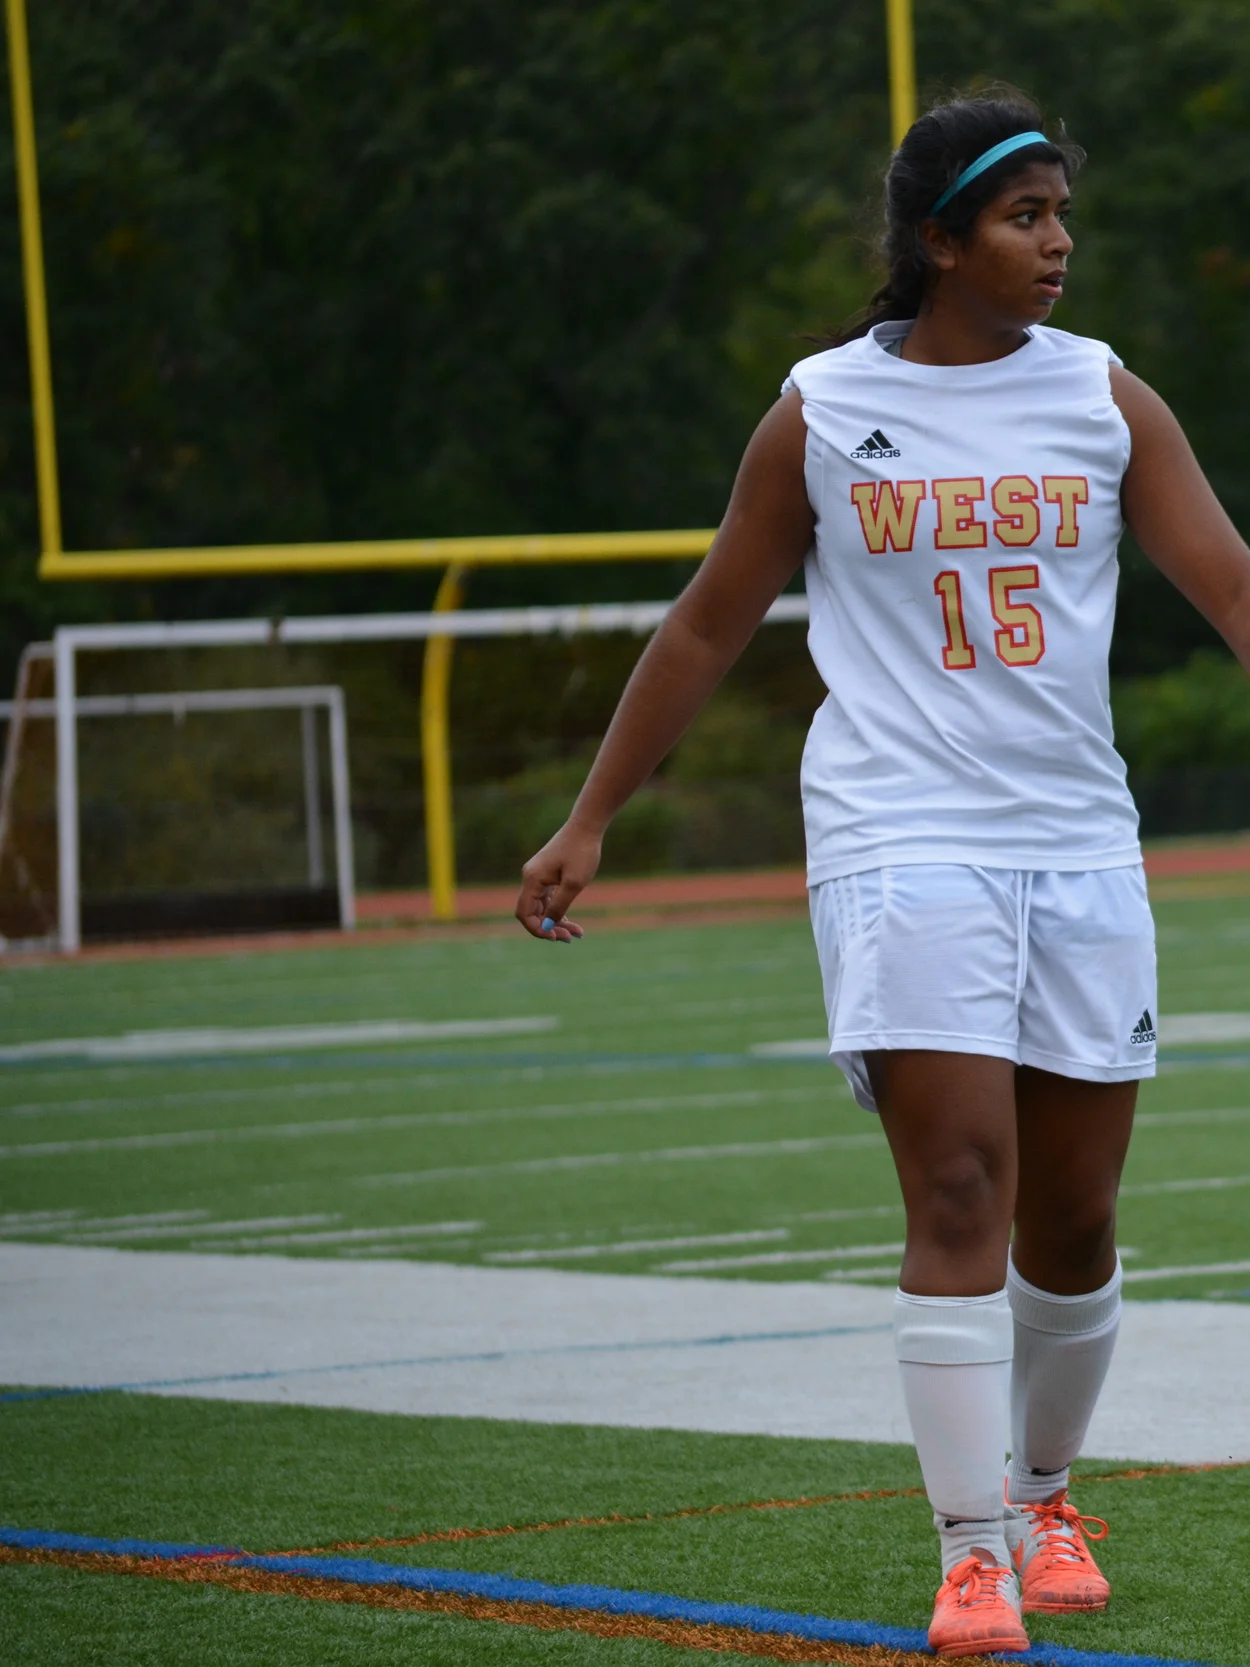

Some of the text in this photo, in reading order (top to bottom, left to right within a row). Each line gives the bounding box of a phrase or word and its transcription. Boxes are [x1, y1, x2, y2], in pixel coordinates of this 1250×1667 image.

[850, 448, 901, 459] adidas
[851, 474, 1089, 555] WEST
[933, 564, 1046, 670] 15
[1130, 1031, 1156, 1044] adidas
